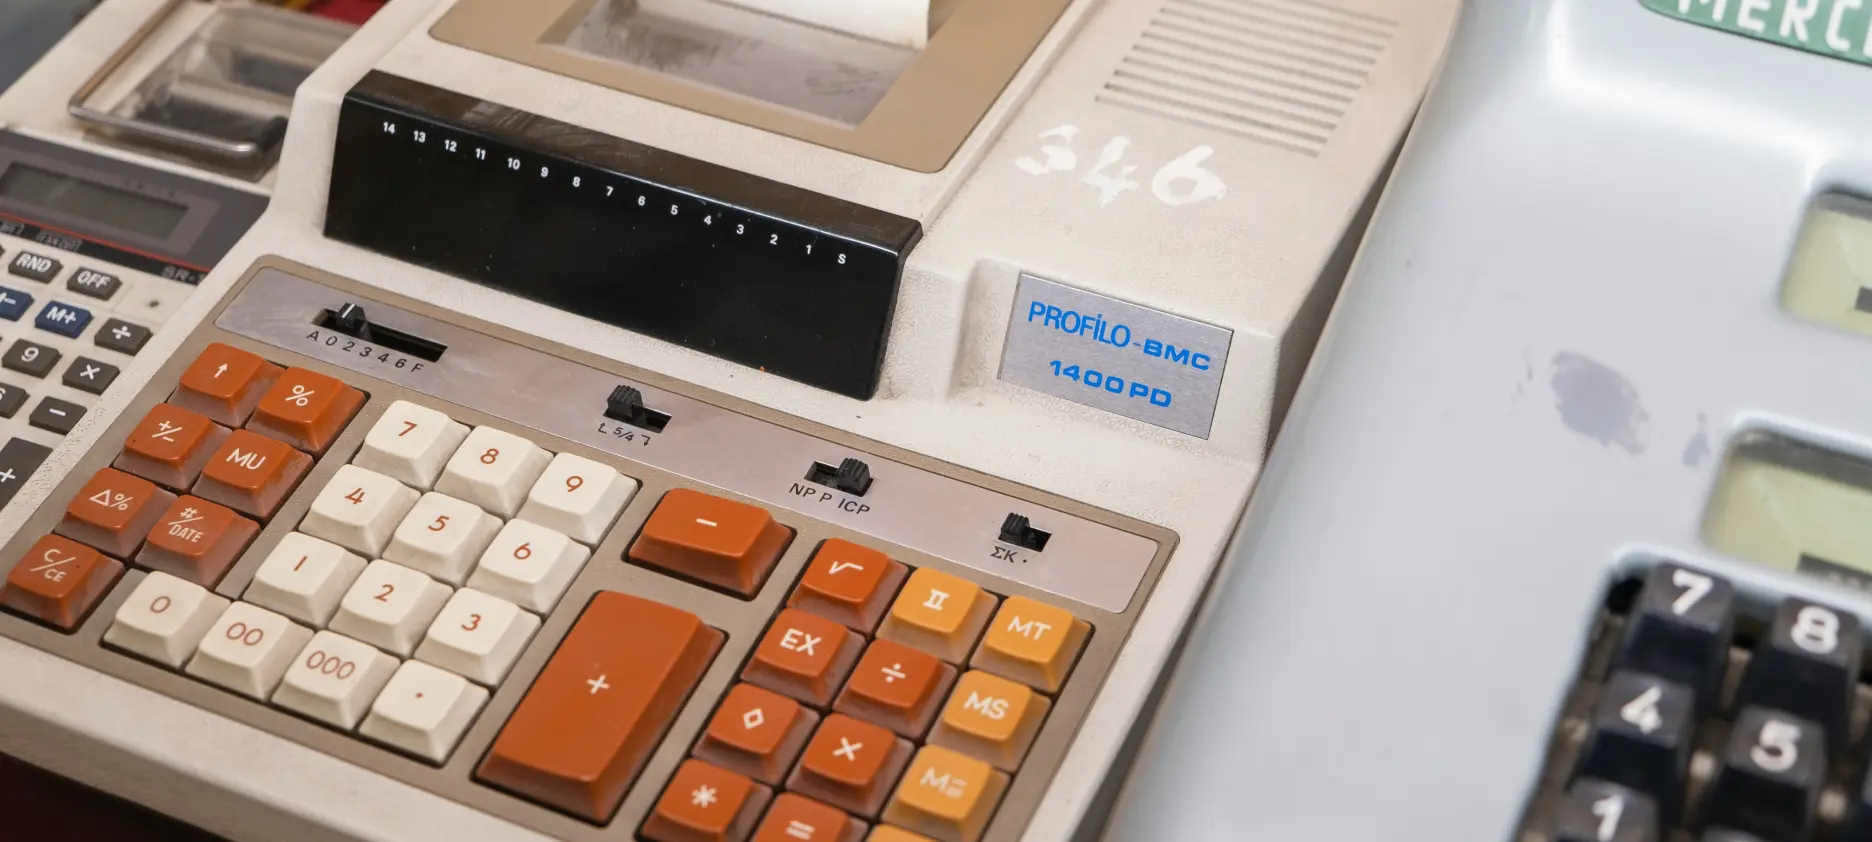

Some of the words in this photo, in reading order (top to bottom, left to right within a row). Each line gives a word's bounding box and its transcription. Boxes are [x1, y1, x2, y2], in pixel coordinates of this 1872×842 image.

[1677, 0, 1872, 56] ERC
[1014, 124, 1228, 209] 346
[383, 121, 396, 135] 14
[413, 130, 427, 143] 13
[444, 139, 458, 153] 12
[475, 147, 486, 161] 11
[507, 157, 521, 171] 10
[540, 166, 549, 178] 9
[572, 176, 581, 188] 8
[606, 185, 614, 197] 7
[637, 195, 646, 207] 6
[670, 204, 679, 216] 5
[703, 214, 712, 226] 4
[736, 223, 745, 235] 3
[769, 233, 779, 246] 2
[805, 244, 812, 255] 1
[837, 253, 847, 265] S
[15, 252, 53, 273] RND
[76, 270, 111, 289] OFF
[46, 305, 77, 325] M+
[21, 346, 40, 363] 9
[305, 330, 320, 342] A
[325, 336, 336, 347] 0
[342, 340, 355, 352] 2
[358, 346, 371, 358] 3
[377, 352, 390, 363] 4
[394, 358, 407, 369] 6
[410, 362, 425, 373] F
[1049, 359, 1125, 394] 1400
[1129, 381, 1172, 408] PD
[398, 420, 418, 437] 7
[613, 426, 634, 442] 5/4
[225, 447, 267, 470] MU
[479, 447, 500, 465] 8
[565, 475, 584, 493] 9
[344, 487, 366, 505] 4
[788, 482, 816, 498] NP
[818, 492, 833, 503] P
[837, 497, 871, 515] ICP
[168, 523, 205, 543] DATE
[427, 514, 450, 532] 5
[513, 542, 532, 561] 6
[293, 555, 309, 572] 1
[373, 583, 395, 603] 2
[1672, 568, 1714, 616] 7
[149, 595, 172, 614] 0
[225, 621, 265, 647] 00
[460, 613, 482, 632] 3
[1007, 615, 1052, 641] MT
[1791, 605, 1840, 654] 8
[779, 627, 823, 657] EX
[305, 650, 356, 681] 000
[963, 690, 1009, 720] MS
[1621, 685, 1663, 734] 4
[1750, 719, 1802, 772] 5
[1592, 794, 1625, 842] 1
